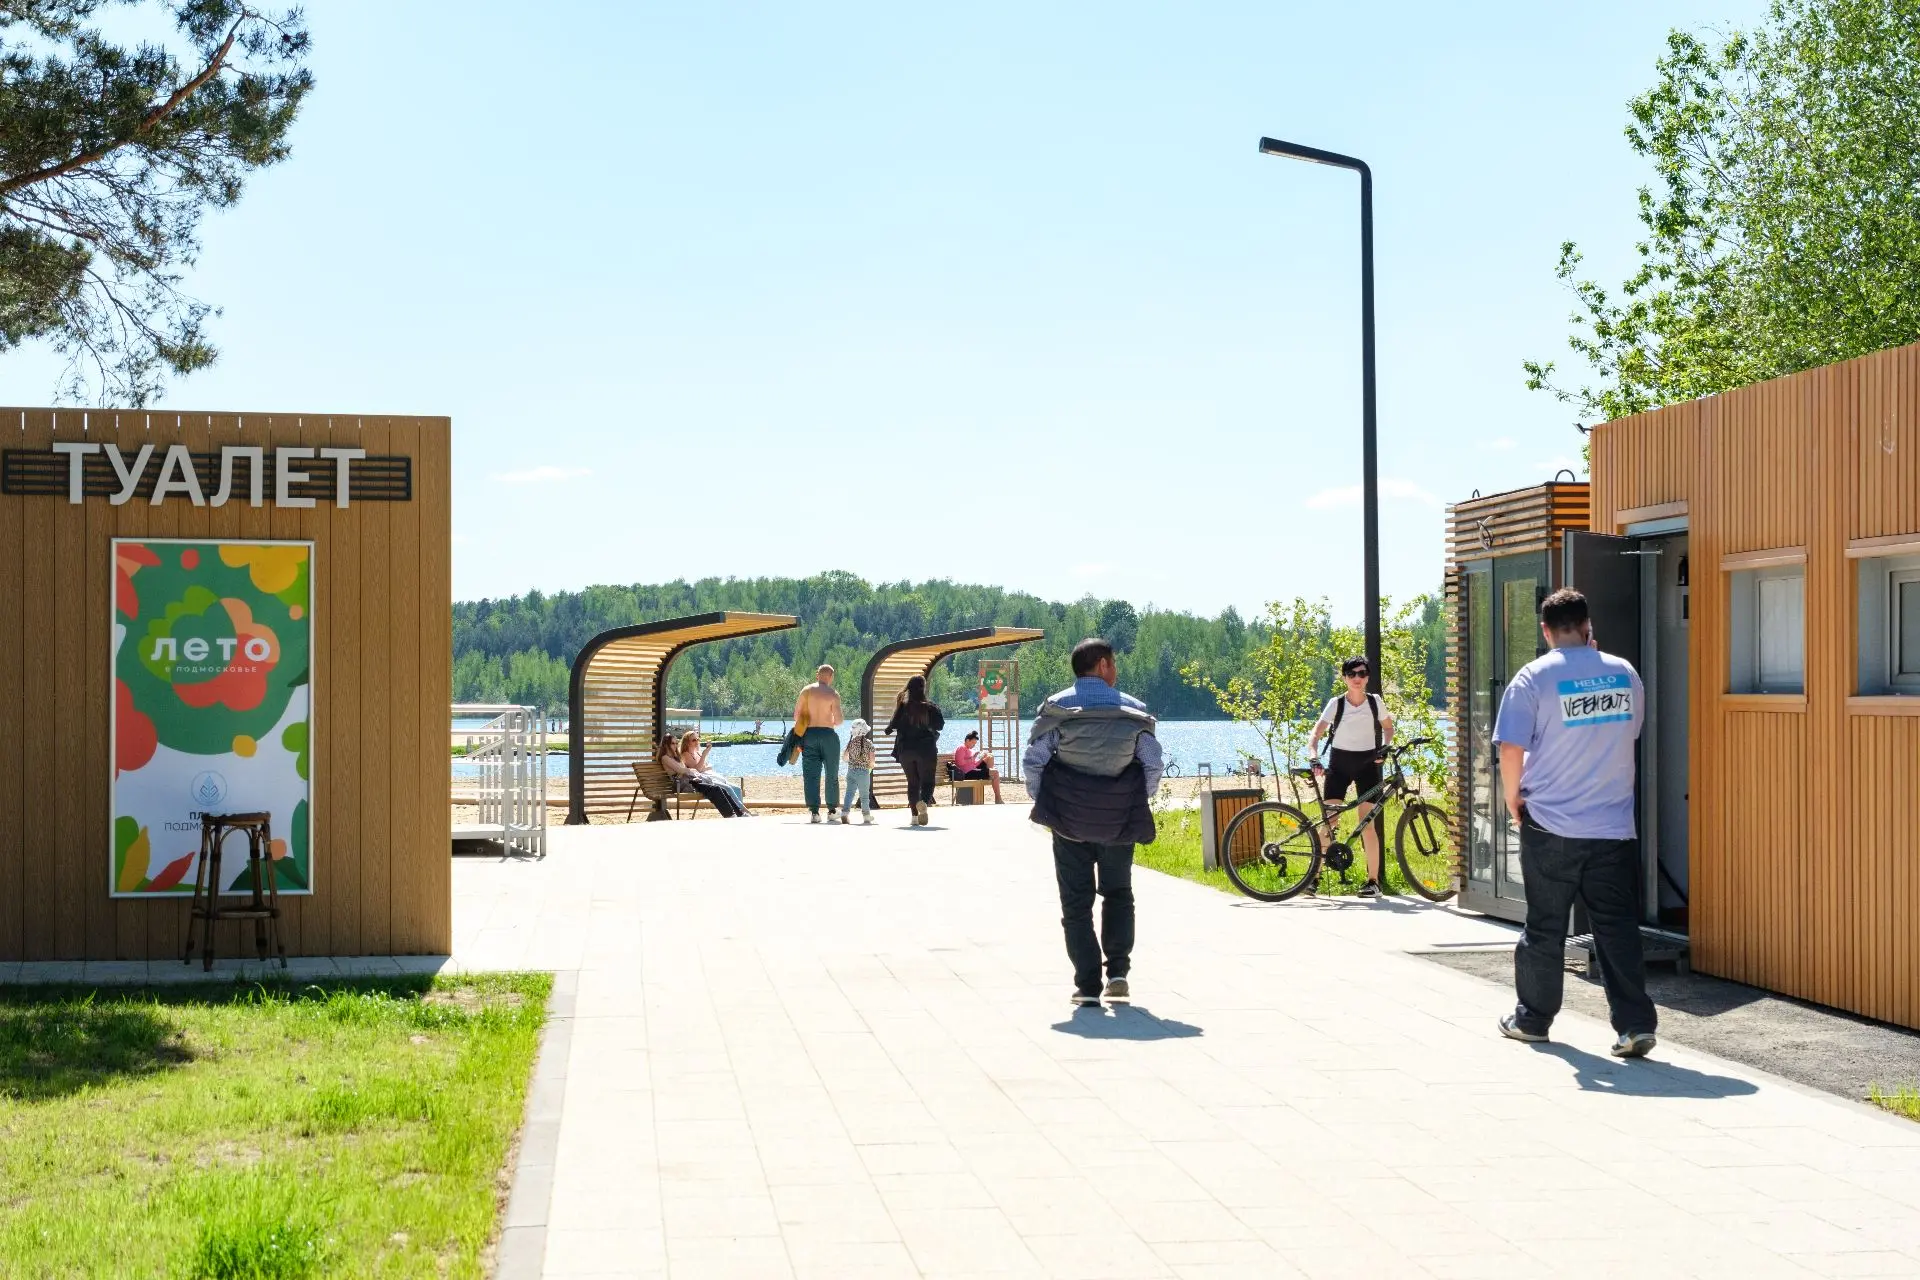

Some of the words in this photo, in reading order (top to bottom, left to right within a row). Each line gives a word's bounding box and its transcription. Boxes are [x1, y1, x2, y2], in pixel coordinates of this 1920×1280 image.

[52, 442, 367, 509] ТУАЛЕТ
[1573, 675, 1617, 689] HELLO
[1563, 693, 1631, 718] VETEMENTS
